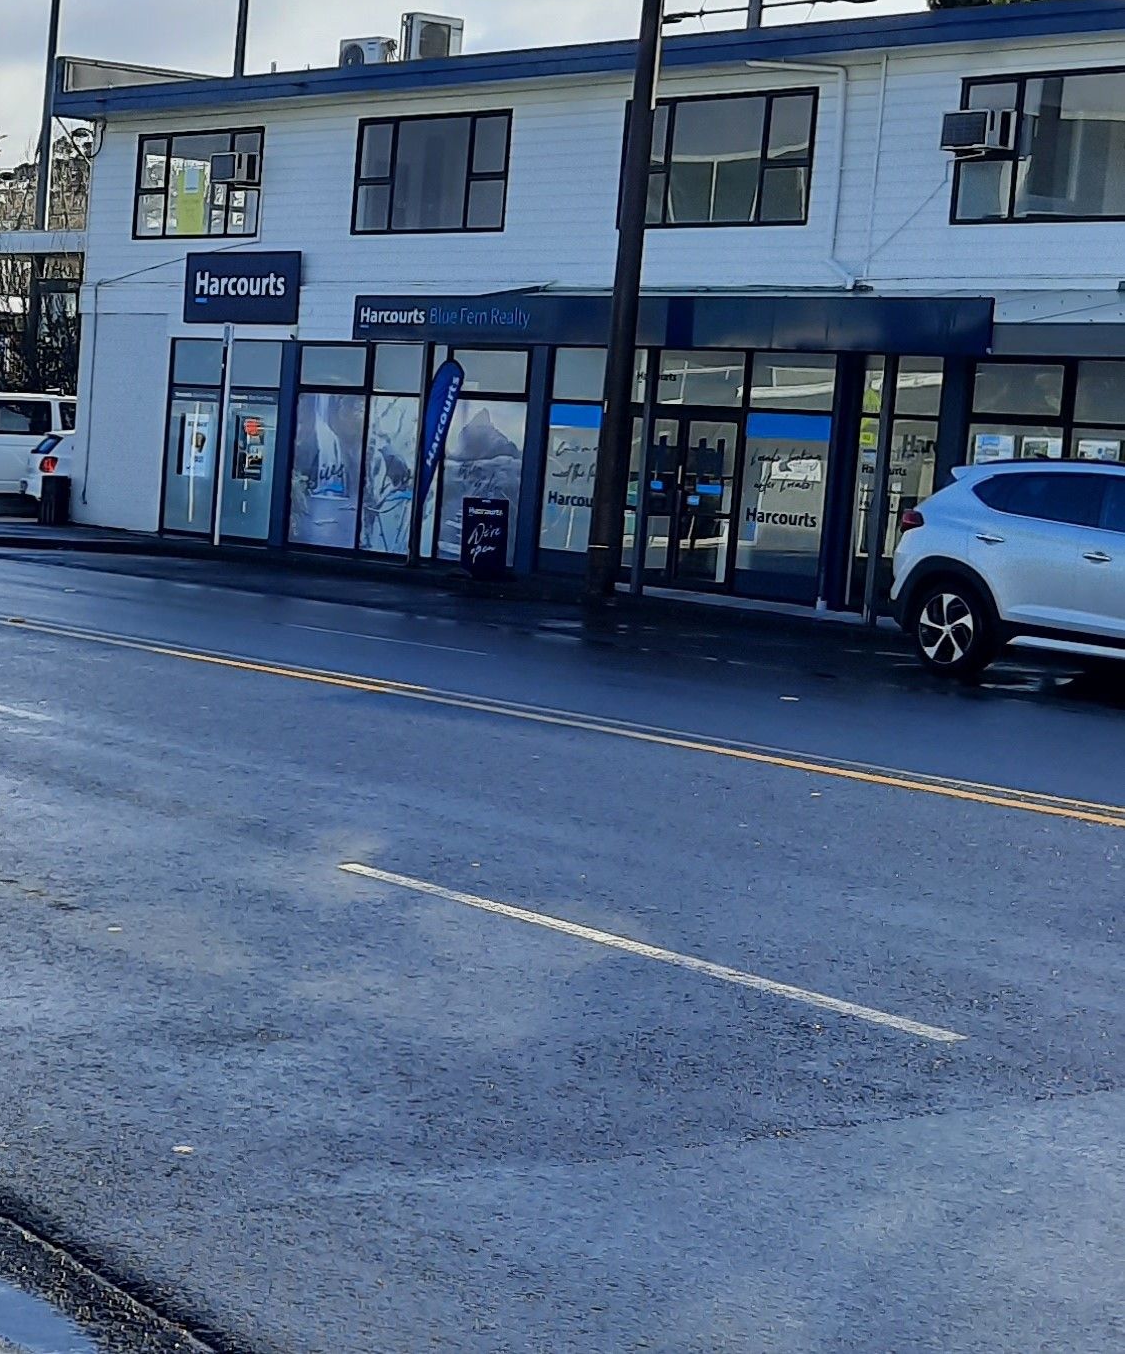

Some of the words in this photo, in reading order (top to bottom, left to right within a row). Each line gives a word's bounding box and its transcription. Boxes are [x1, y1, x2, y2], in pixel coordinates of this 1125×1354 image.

[195, 271, 285, 296] Harcourts
[360, 306, 425, 325] Harcourts
[429, 307, 458, 325] Blue
[460, 307, 488, 325] Fern
[490, 306, 531, 330] Realty
[425, 375, 461, 467] Harcourts
[746, 507, 817, 528] Harcourts
